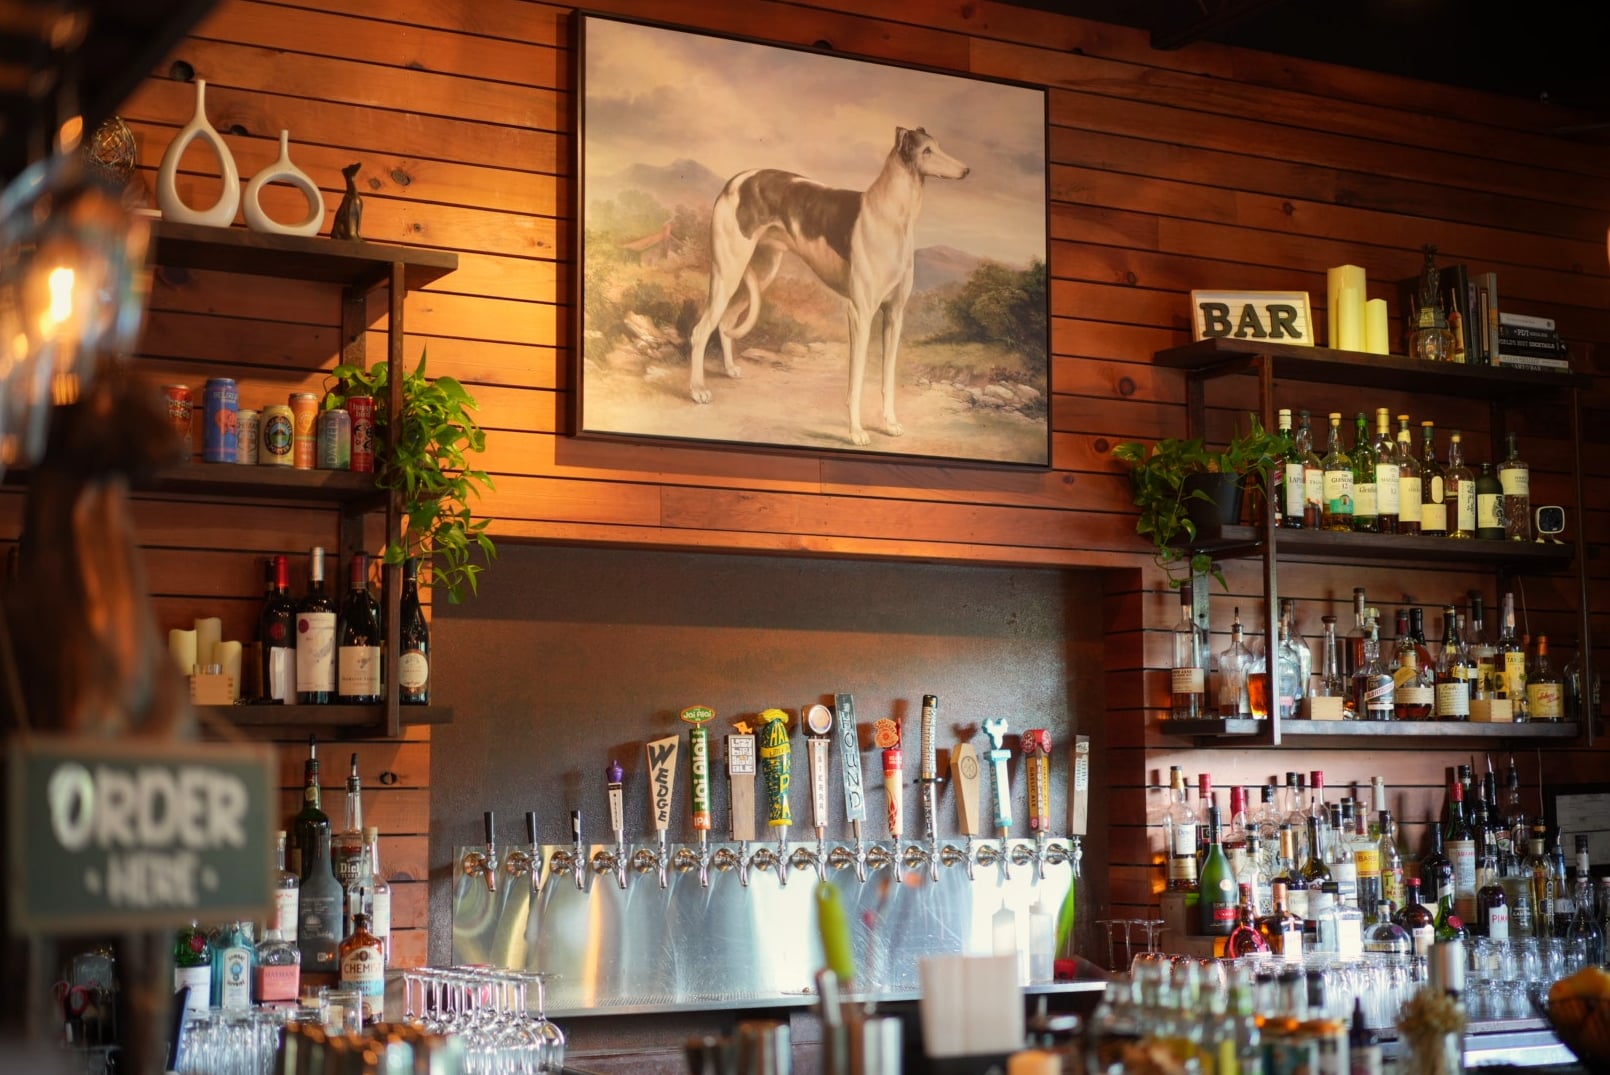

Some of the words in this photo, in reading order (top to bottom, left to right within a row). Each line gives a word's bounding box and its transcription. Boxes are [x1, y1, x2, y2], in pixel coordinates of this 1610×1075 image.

[1199, 302, 1303, 340] BAR
[48, 763, 248, 851] ORDER
[648, 743, 677, 822] WEDGE
[694, 816, 710, 827] IPA
[107, 853, 199, 907] HERE
